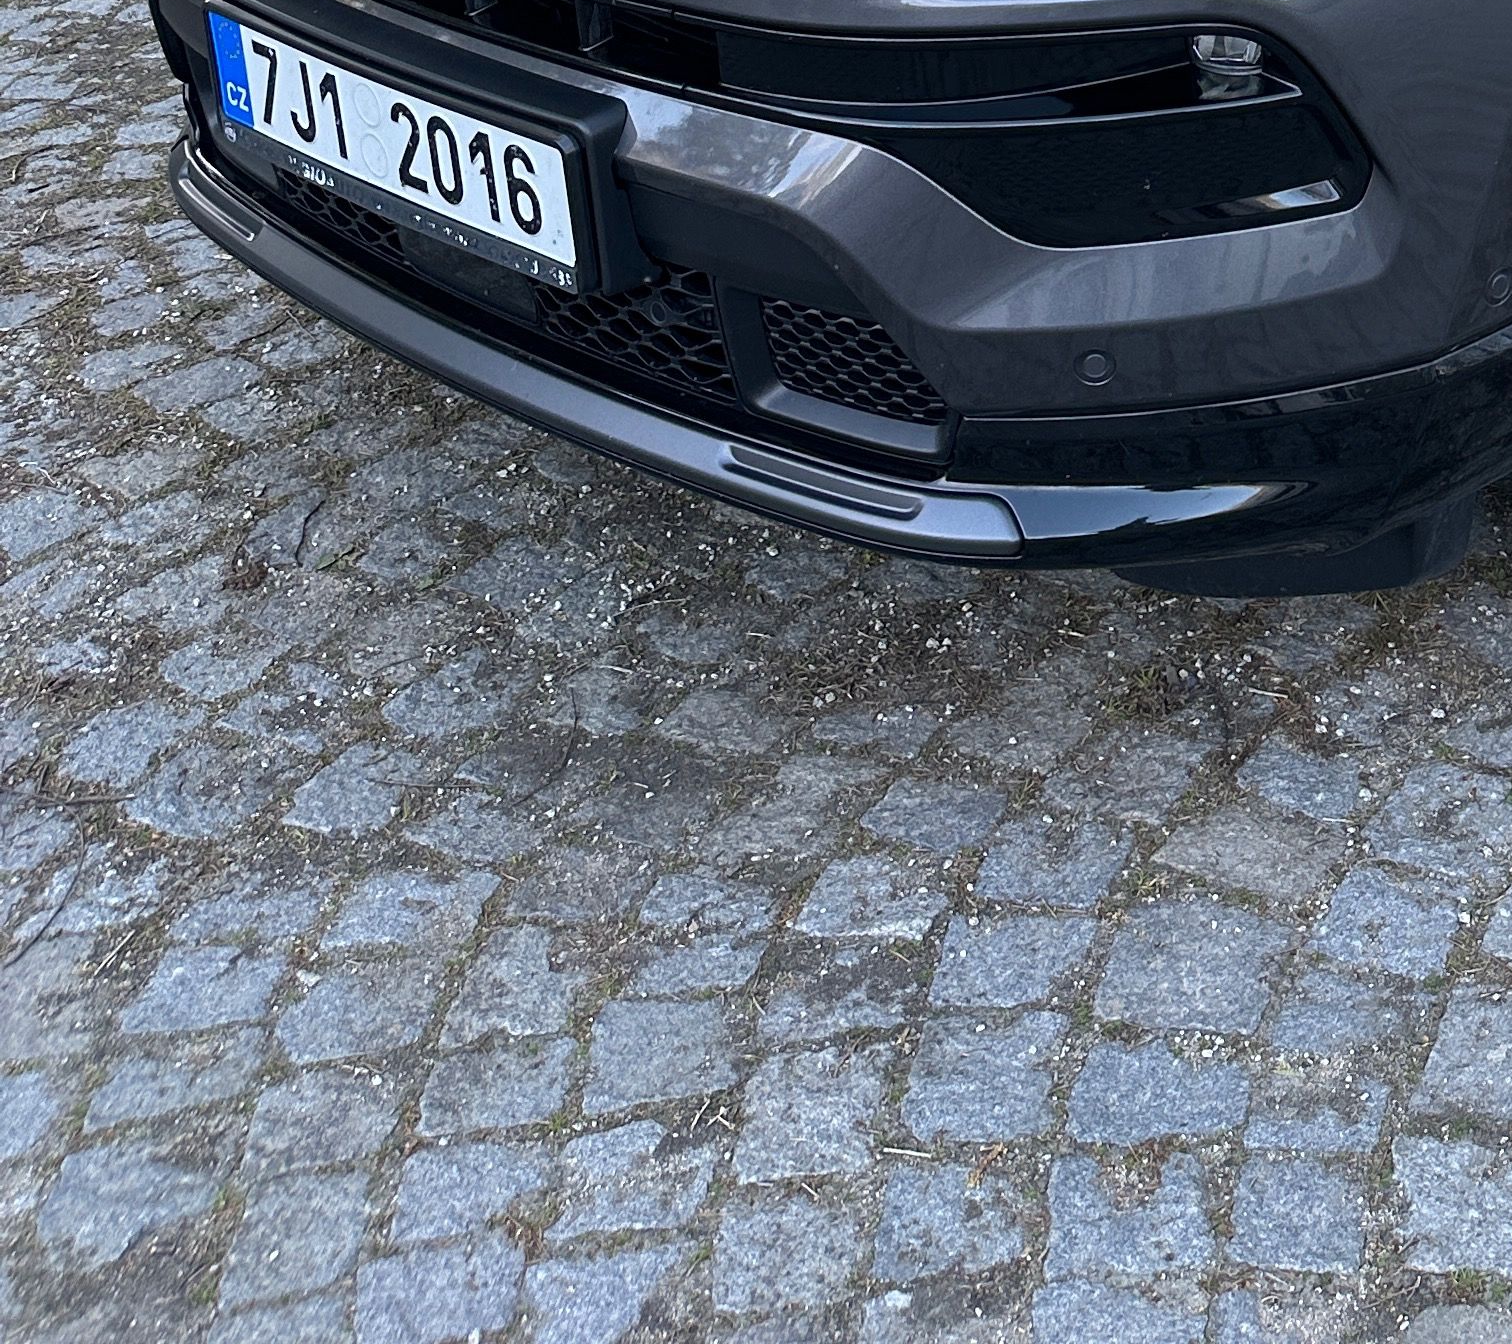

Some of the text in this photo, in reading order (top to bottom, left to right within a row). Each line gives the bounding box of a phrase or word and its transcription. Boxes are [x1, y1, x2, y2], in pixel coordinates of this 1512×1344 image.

[226, 81, 249, 112] CZ
[251, 39, 543, 236] 7J1 2016
